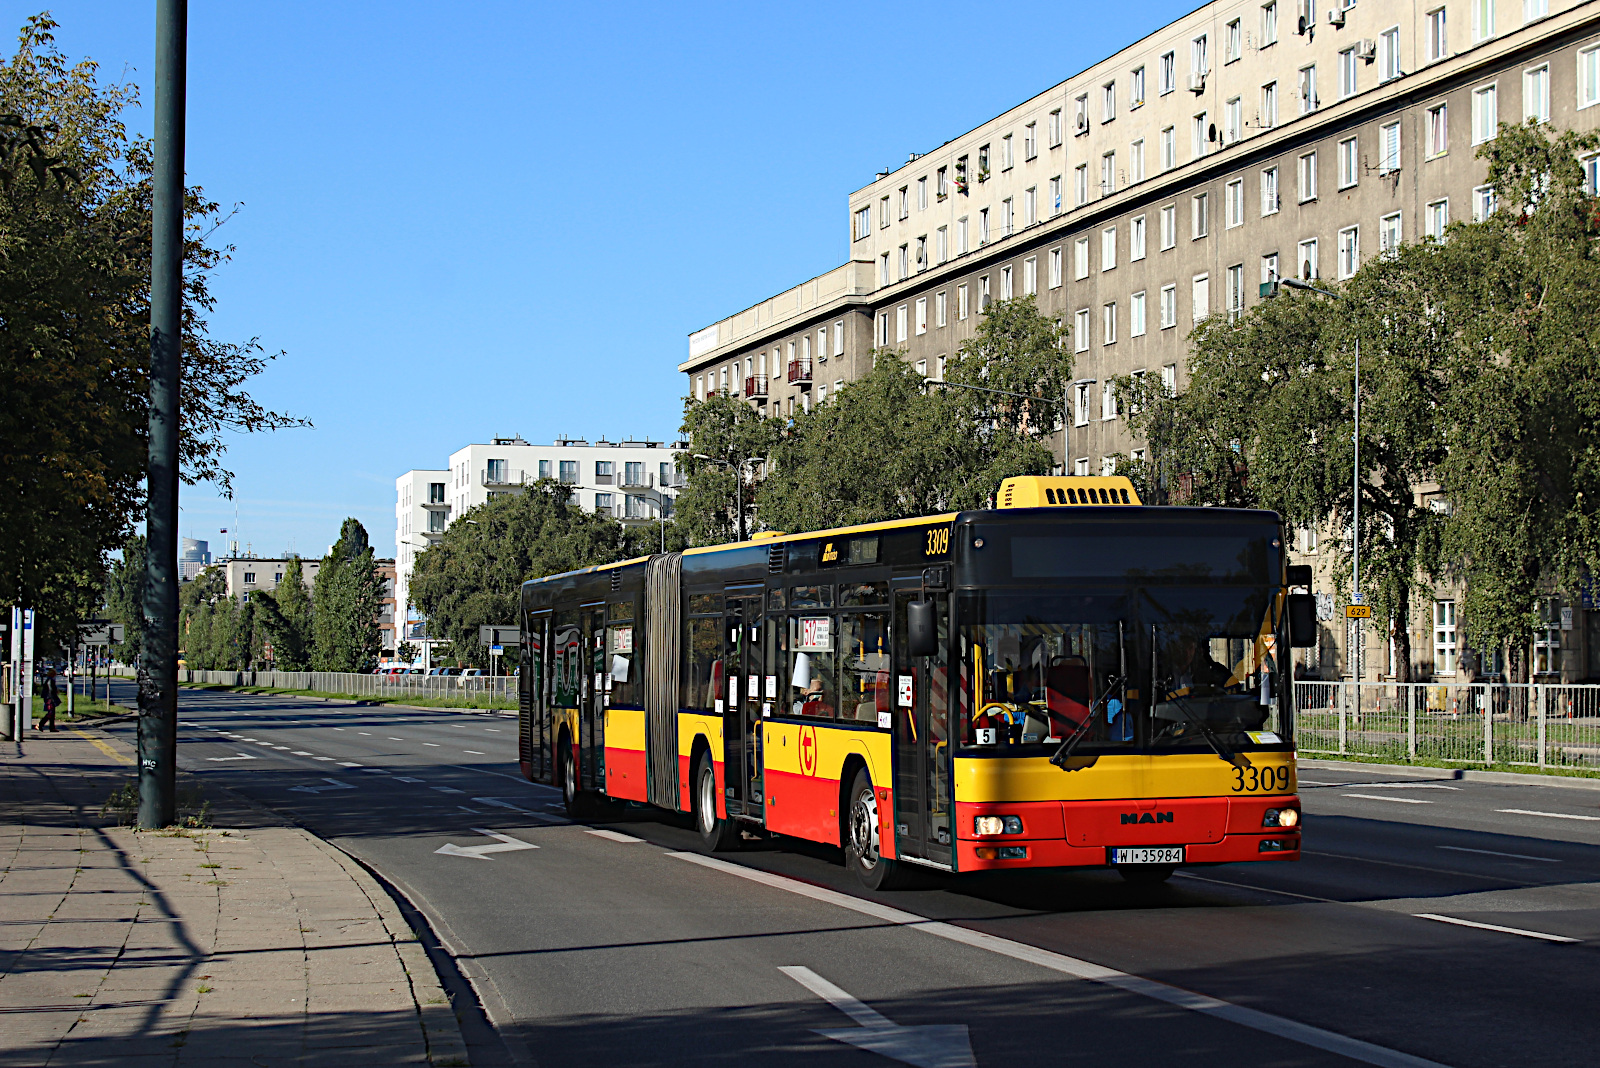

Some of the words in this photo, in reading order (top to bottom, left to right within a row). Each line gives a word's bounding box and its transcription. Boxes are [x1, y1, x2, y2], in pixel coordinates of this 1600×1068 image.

[925, 527, 949, 556] 3309
[1351, 608, 1366, 616] 629
[804, 619, 817, 646] 512
[982, 729, 990, 743] 5
[1231, 766, 1290, 791] 3309
[1120, 811, 1174, 825] MAN
[1120, 849, 1134, 863] WI
[1141, 849, 1180, 863] 35984
